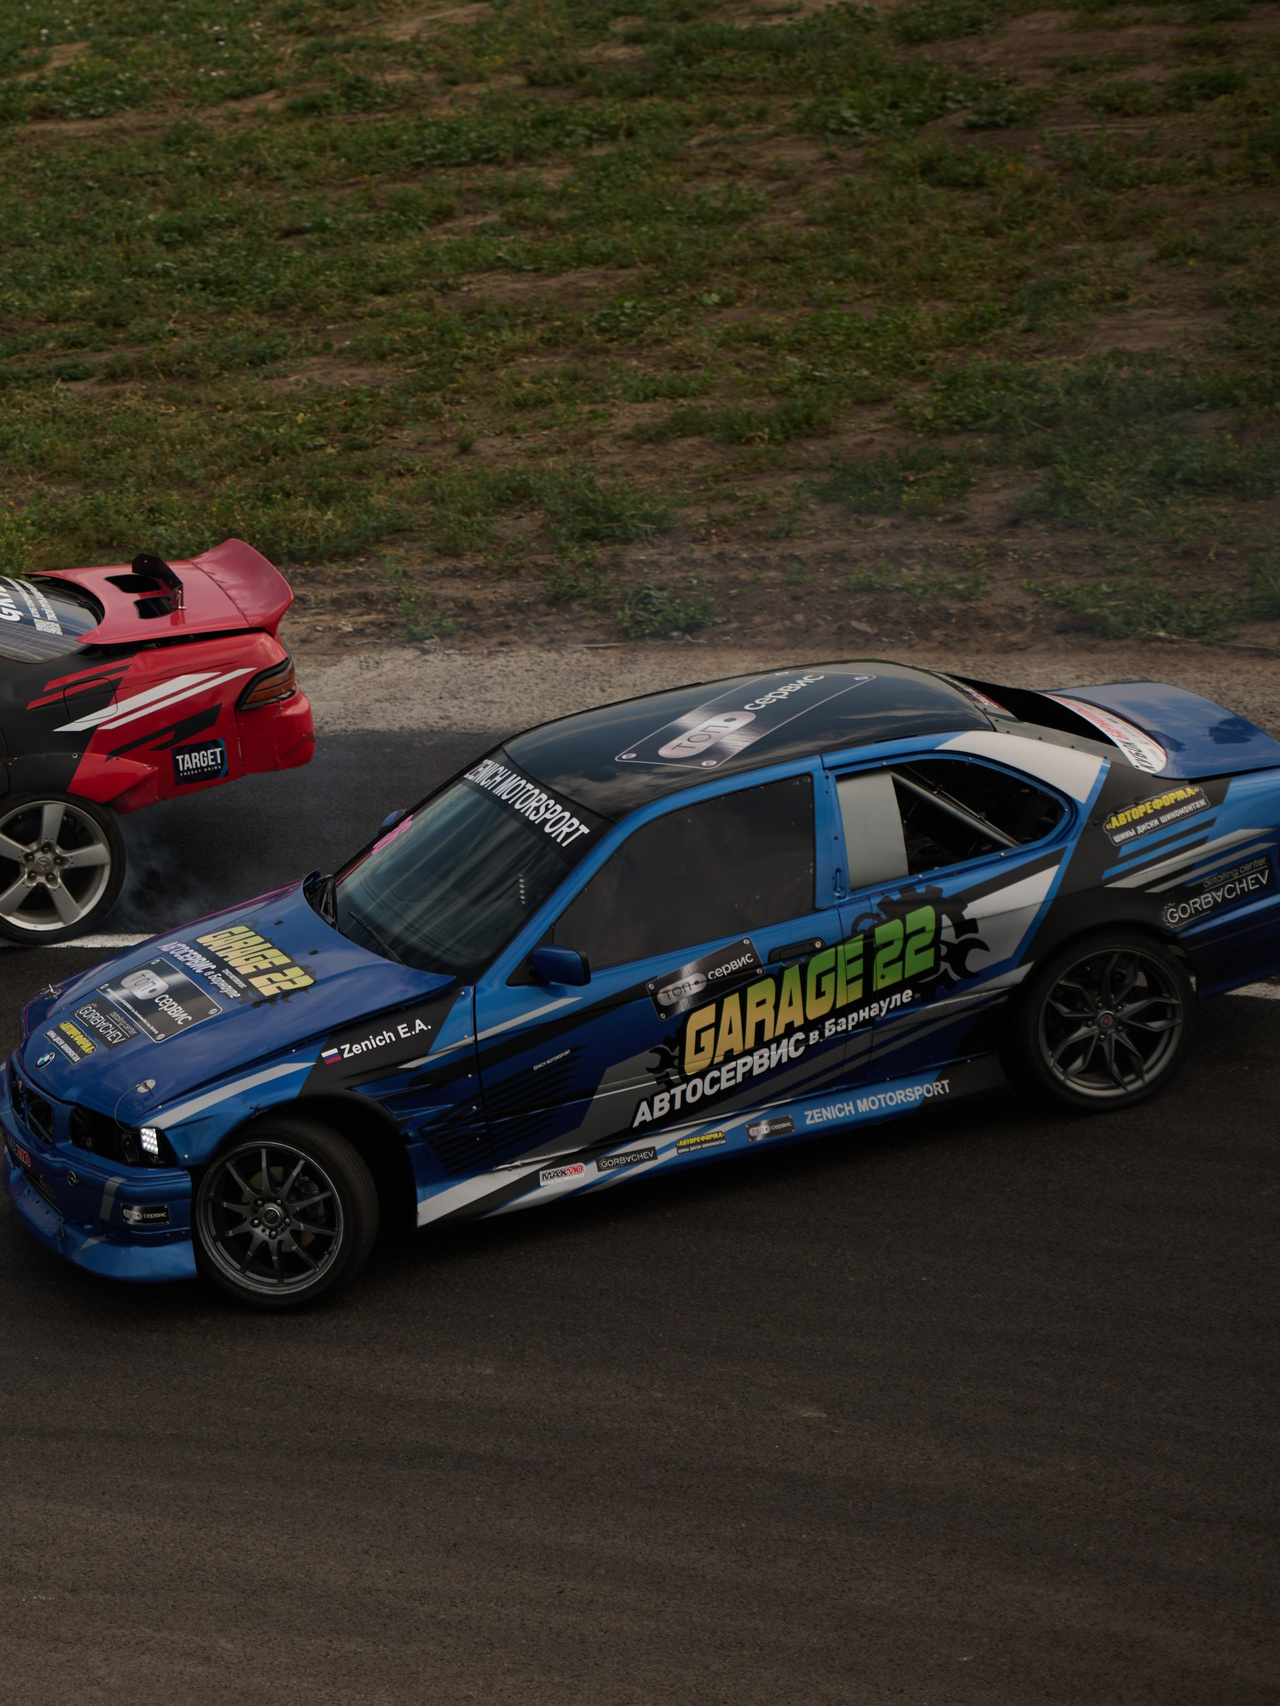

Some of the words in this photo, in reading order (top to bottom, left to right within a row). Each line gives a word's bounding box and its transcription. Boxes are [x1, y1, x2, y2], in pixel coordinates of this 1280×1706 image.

[671, 724, 730, 751] ТОП
[743, 674, 825, 711] сервис
[175, 747, 223, 771] TARGET
[463, 759, 512, 791] ZENICH
[492, 773, 591, 848] MOTORSPORT
[1239, 857, 1267, 873] center
[196, 925, 292, 975] GARAGE
[248, 966, 316, 997] 22
[664, 981, 693, 1000] ТОП
[707, 953, 755, 980] сервис
[154, 994, 193, 1025] сервис
[683, 933, 866, 1077] GARAGE
[872, 904, 937, 993] 22
[340, 1030, 397, 1059] Zenich
[396, 1018, 432, 1039] E.A.
[632, 1031, 807, 1128] АВТОСЕРВИС
[823, 988, 914, 1038] Барнауле
[804, 1101, 856, 1126] ZENICH
[856, 1079, 951, 1113] MOTORSPORT
